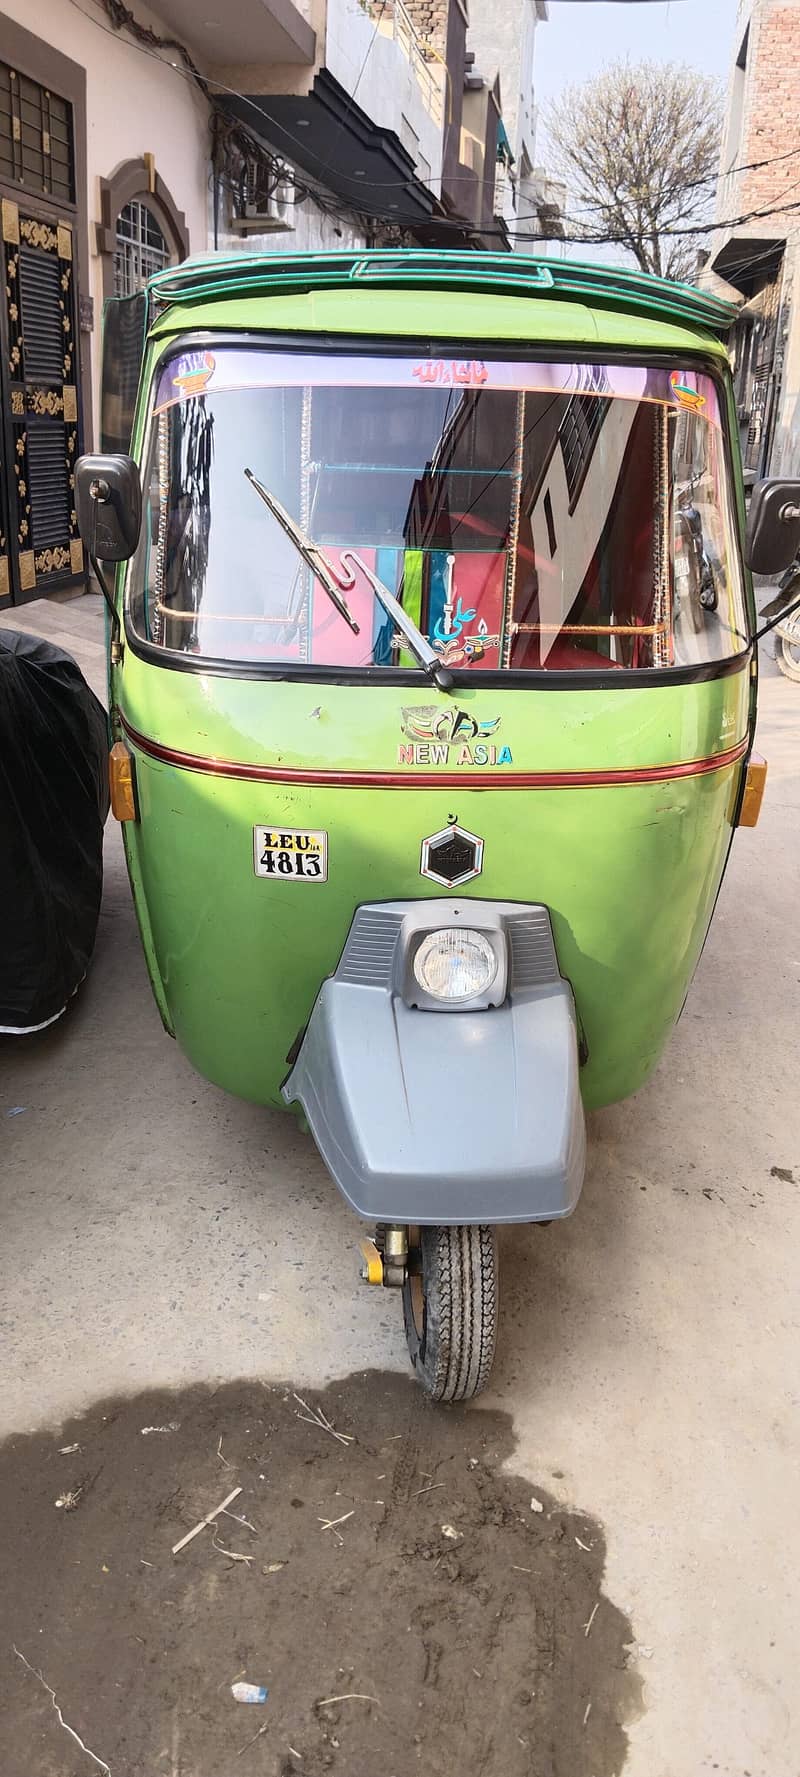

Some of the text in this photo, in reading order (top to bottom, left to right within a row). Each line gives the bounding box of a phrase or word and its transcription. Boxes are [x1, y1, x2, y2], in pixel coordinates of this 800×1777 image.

[398, 744, 513, 766] NEW ASIA
[264, 832, 310, 850] LEU
[260, 849, 321, 876] 4813
